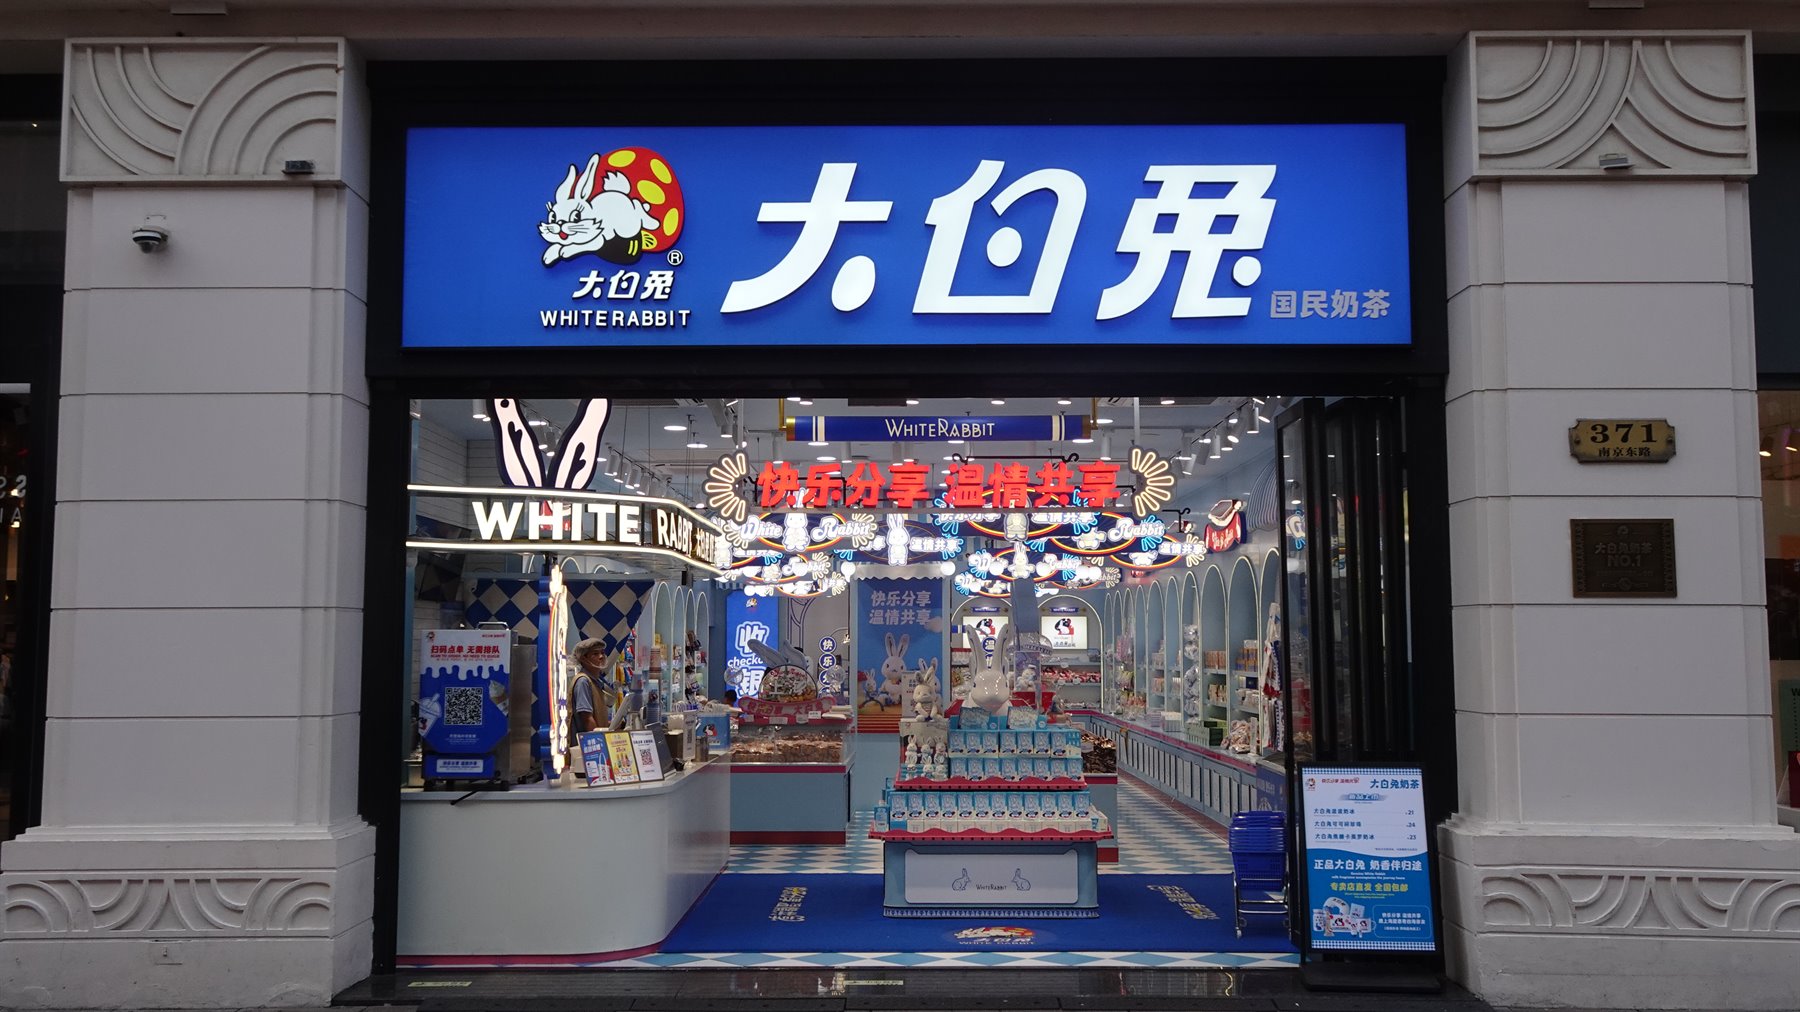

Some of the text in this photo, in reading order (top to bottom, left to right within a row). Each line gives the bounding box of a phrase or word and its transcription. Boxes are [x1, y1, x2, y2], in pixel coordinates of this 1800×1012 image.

[720, 160, 1277, 321] 大白兔
[572, 270, 675, 301] 大白兔
[1270, 289, 1391, 320] 国民奶茶
[1590, 423, 1657, 444] 371
[1598, 447, 1652, 458] 南京东路
[757, 460, 1121, 509] 快乐分享 温情共享
[471, 501, 641, 543] WHITE
[657, 508, 693, 558] RABBIT
[739, 515, 871, 542] White Rabbit
[1108, 517, 1166, 542] Rabbit
[1607, 555, 1642, 567] NO.1
[871, 590, 932, 607] 快乐分享
[868, 608, 932, 625] 温情共享
[430, 645, 500, 654] 扫码点单 无需排队
[1370, 779, 1420, 789] 大白兔奶茶
[1313, 859, 1423, 871] 正品大白兔 奶香伴归途
